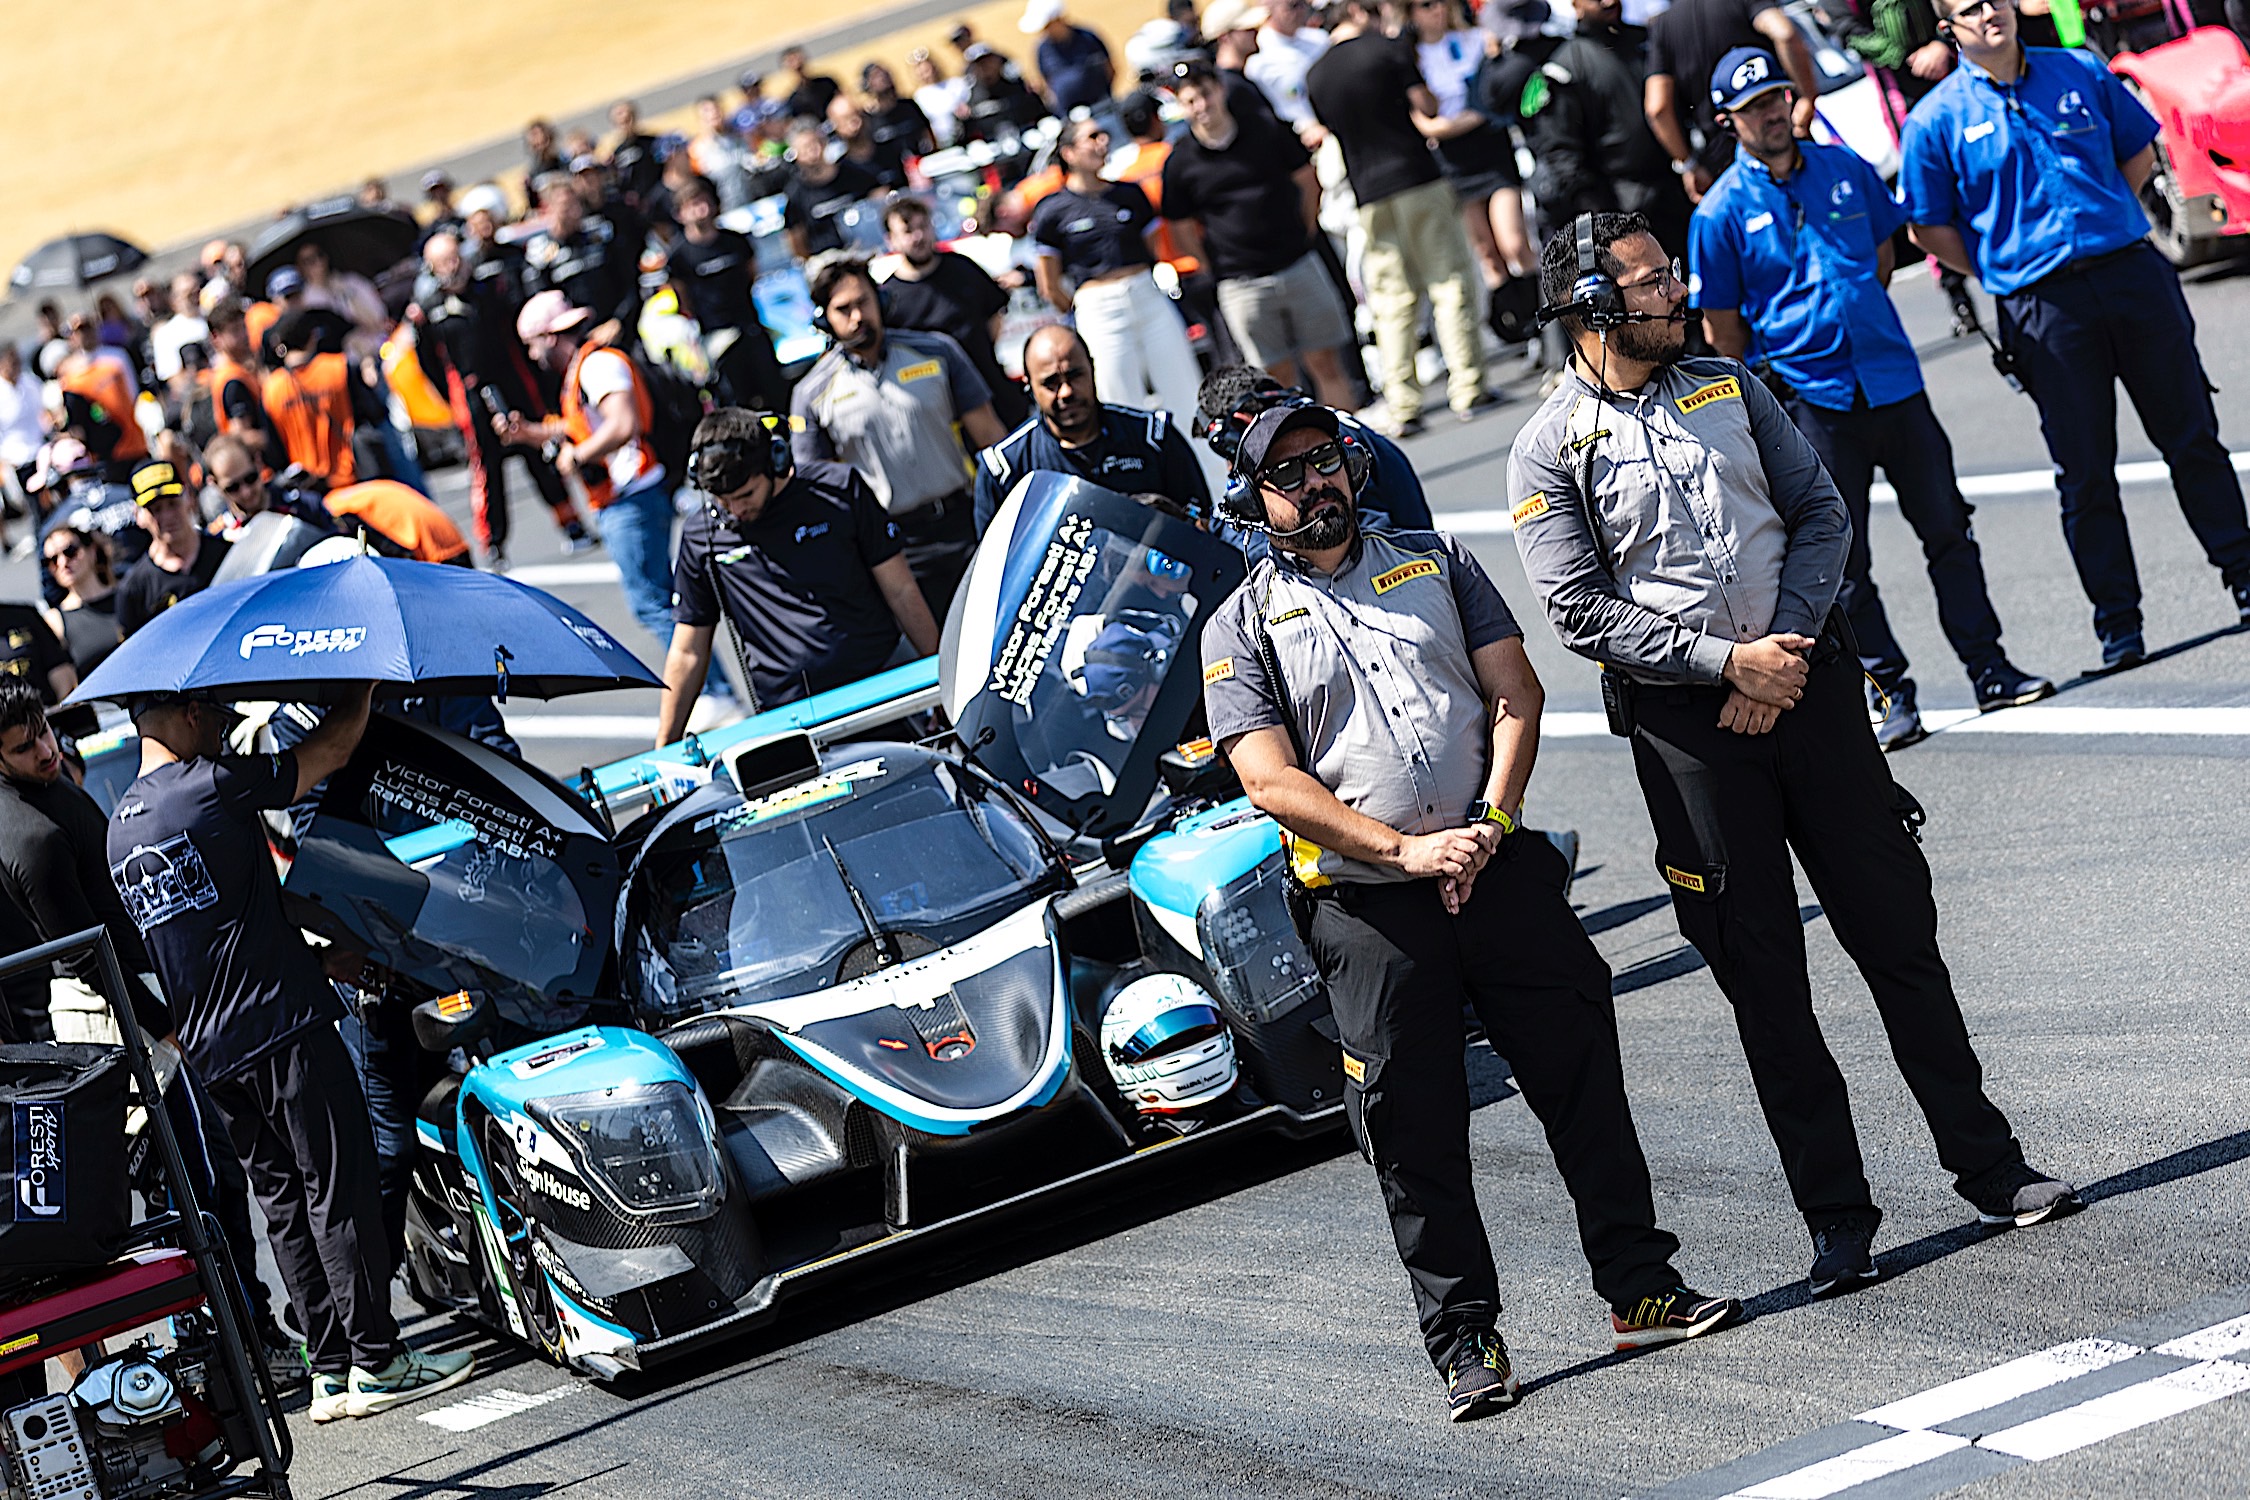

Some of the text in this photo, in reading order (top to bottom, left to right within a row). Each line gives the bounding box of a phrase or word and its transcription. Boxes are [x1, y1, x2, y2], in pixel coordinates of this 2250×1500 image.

[1682, 383, 1735, 409] PIRELLI
[988, 513, 1079, 691] Victor Foresti A+
[999, 518, 1093, 701] Lucas Foresti A+
[1377, 562, 1433, 590] PIRELLI
[239, 624, 367, 660] FORESTI
[1013, 544, 1099, 706] Rafa Martins AB+
[369, 782, 533, 860] Rafa Martins AB+
[374, 769, 558, 858] Lucas Foresti A+
[386, 759, 563, 843] Victor Foresti A+
[693, 756, 888, 833] ENDURANCE
[1669, 869, 1701, 889] PIRELLI
[20, 1106, 61, 1215] FORESTI
[41, 1108, 61, 1171] sports
